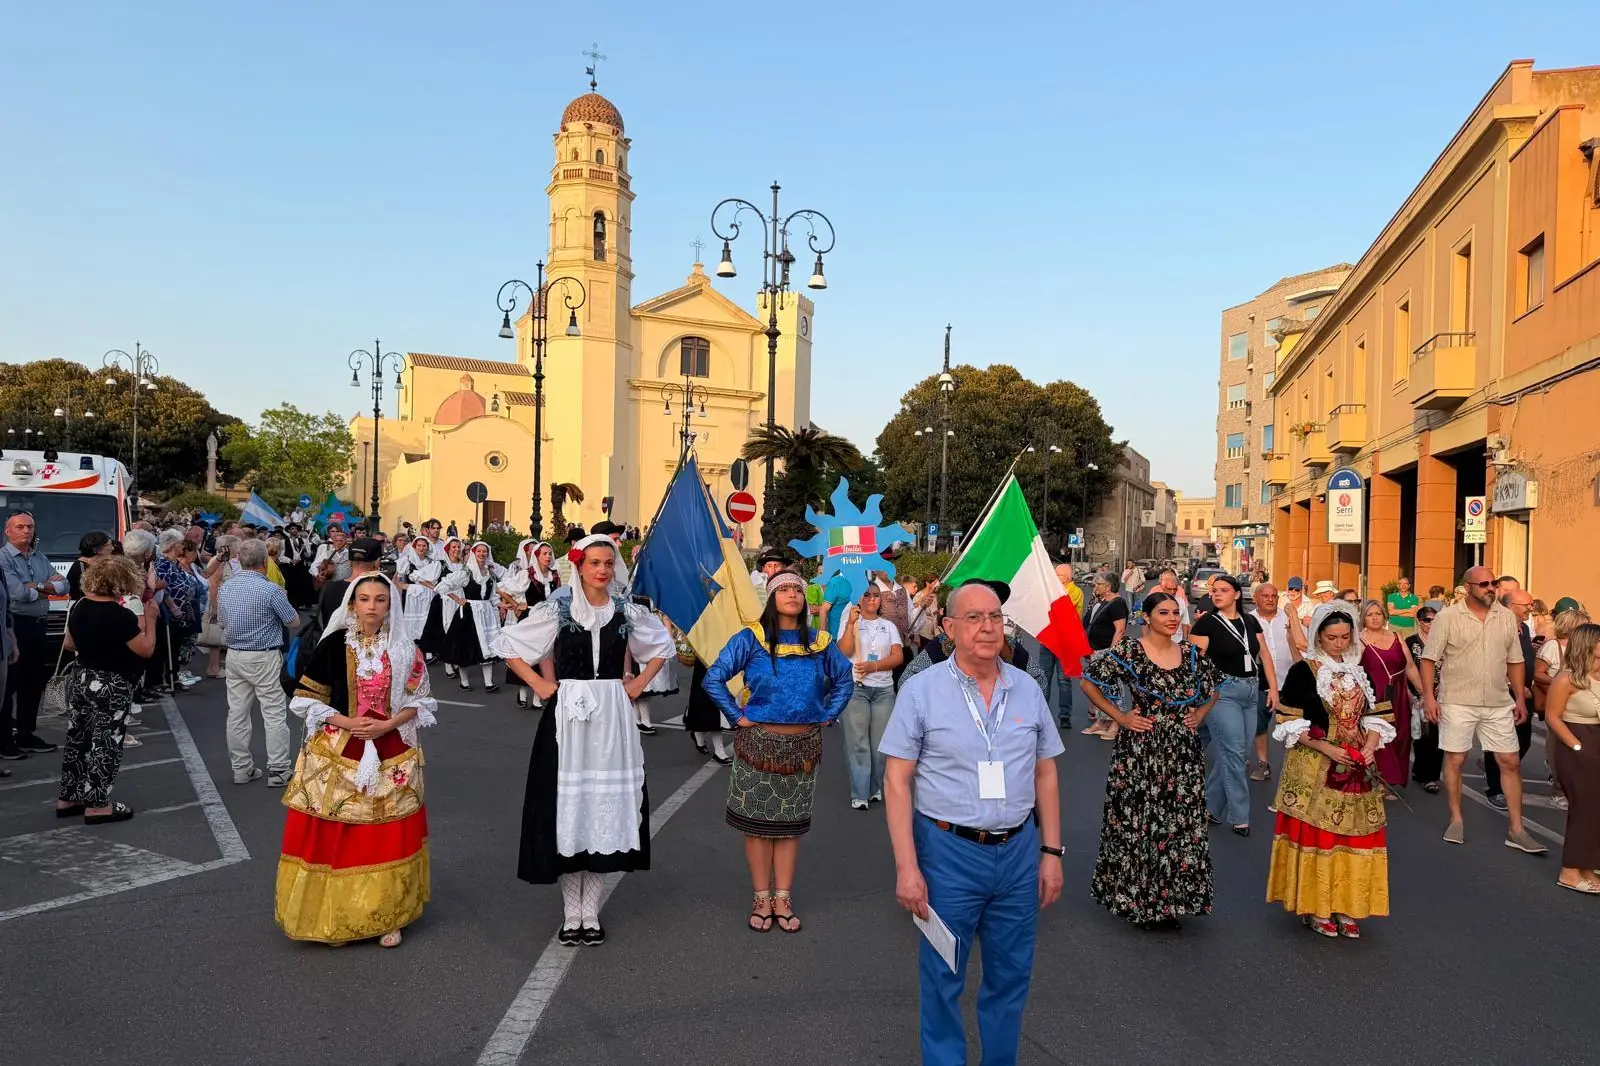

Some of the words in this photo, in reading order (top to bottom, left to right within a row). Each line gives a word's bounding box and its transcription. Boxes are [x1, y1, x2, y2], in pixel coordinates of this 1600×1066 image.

[1336, 506, 1353, 514] Serri
[930, 525, 936, 534] P
[1070, 535, 1077, 544] P
